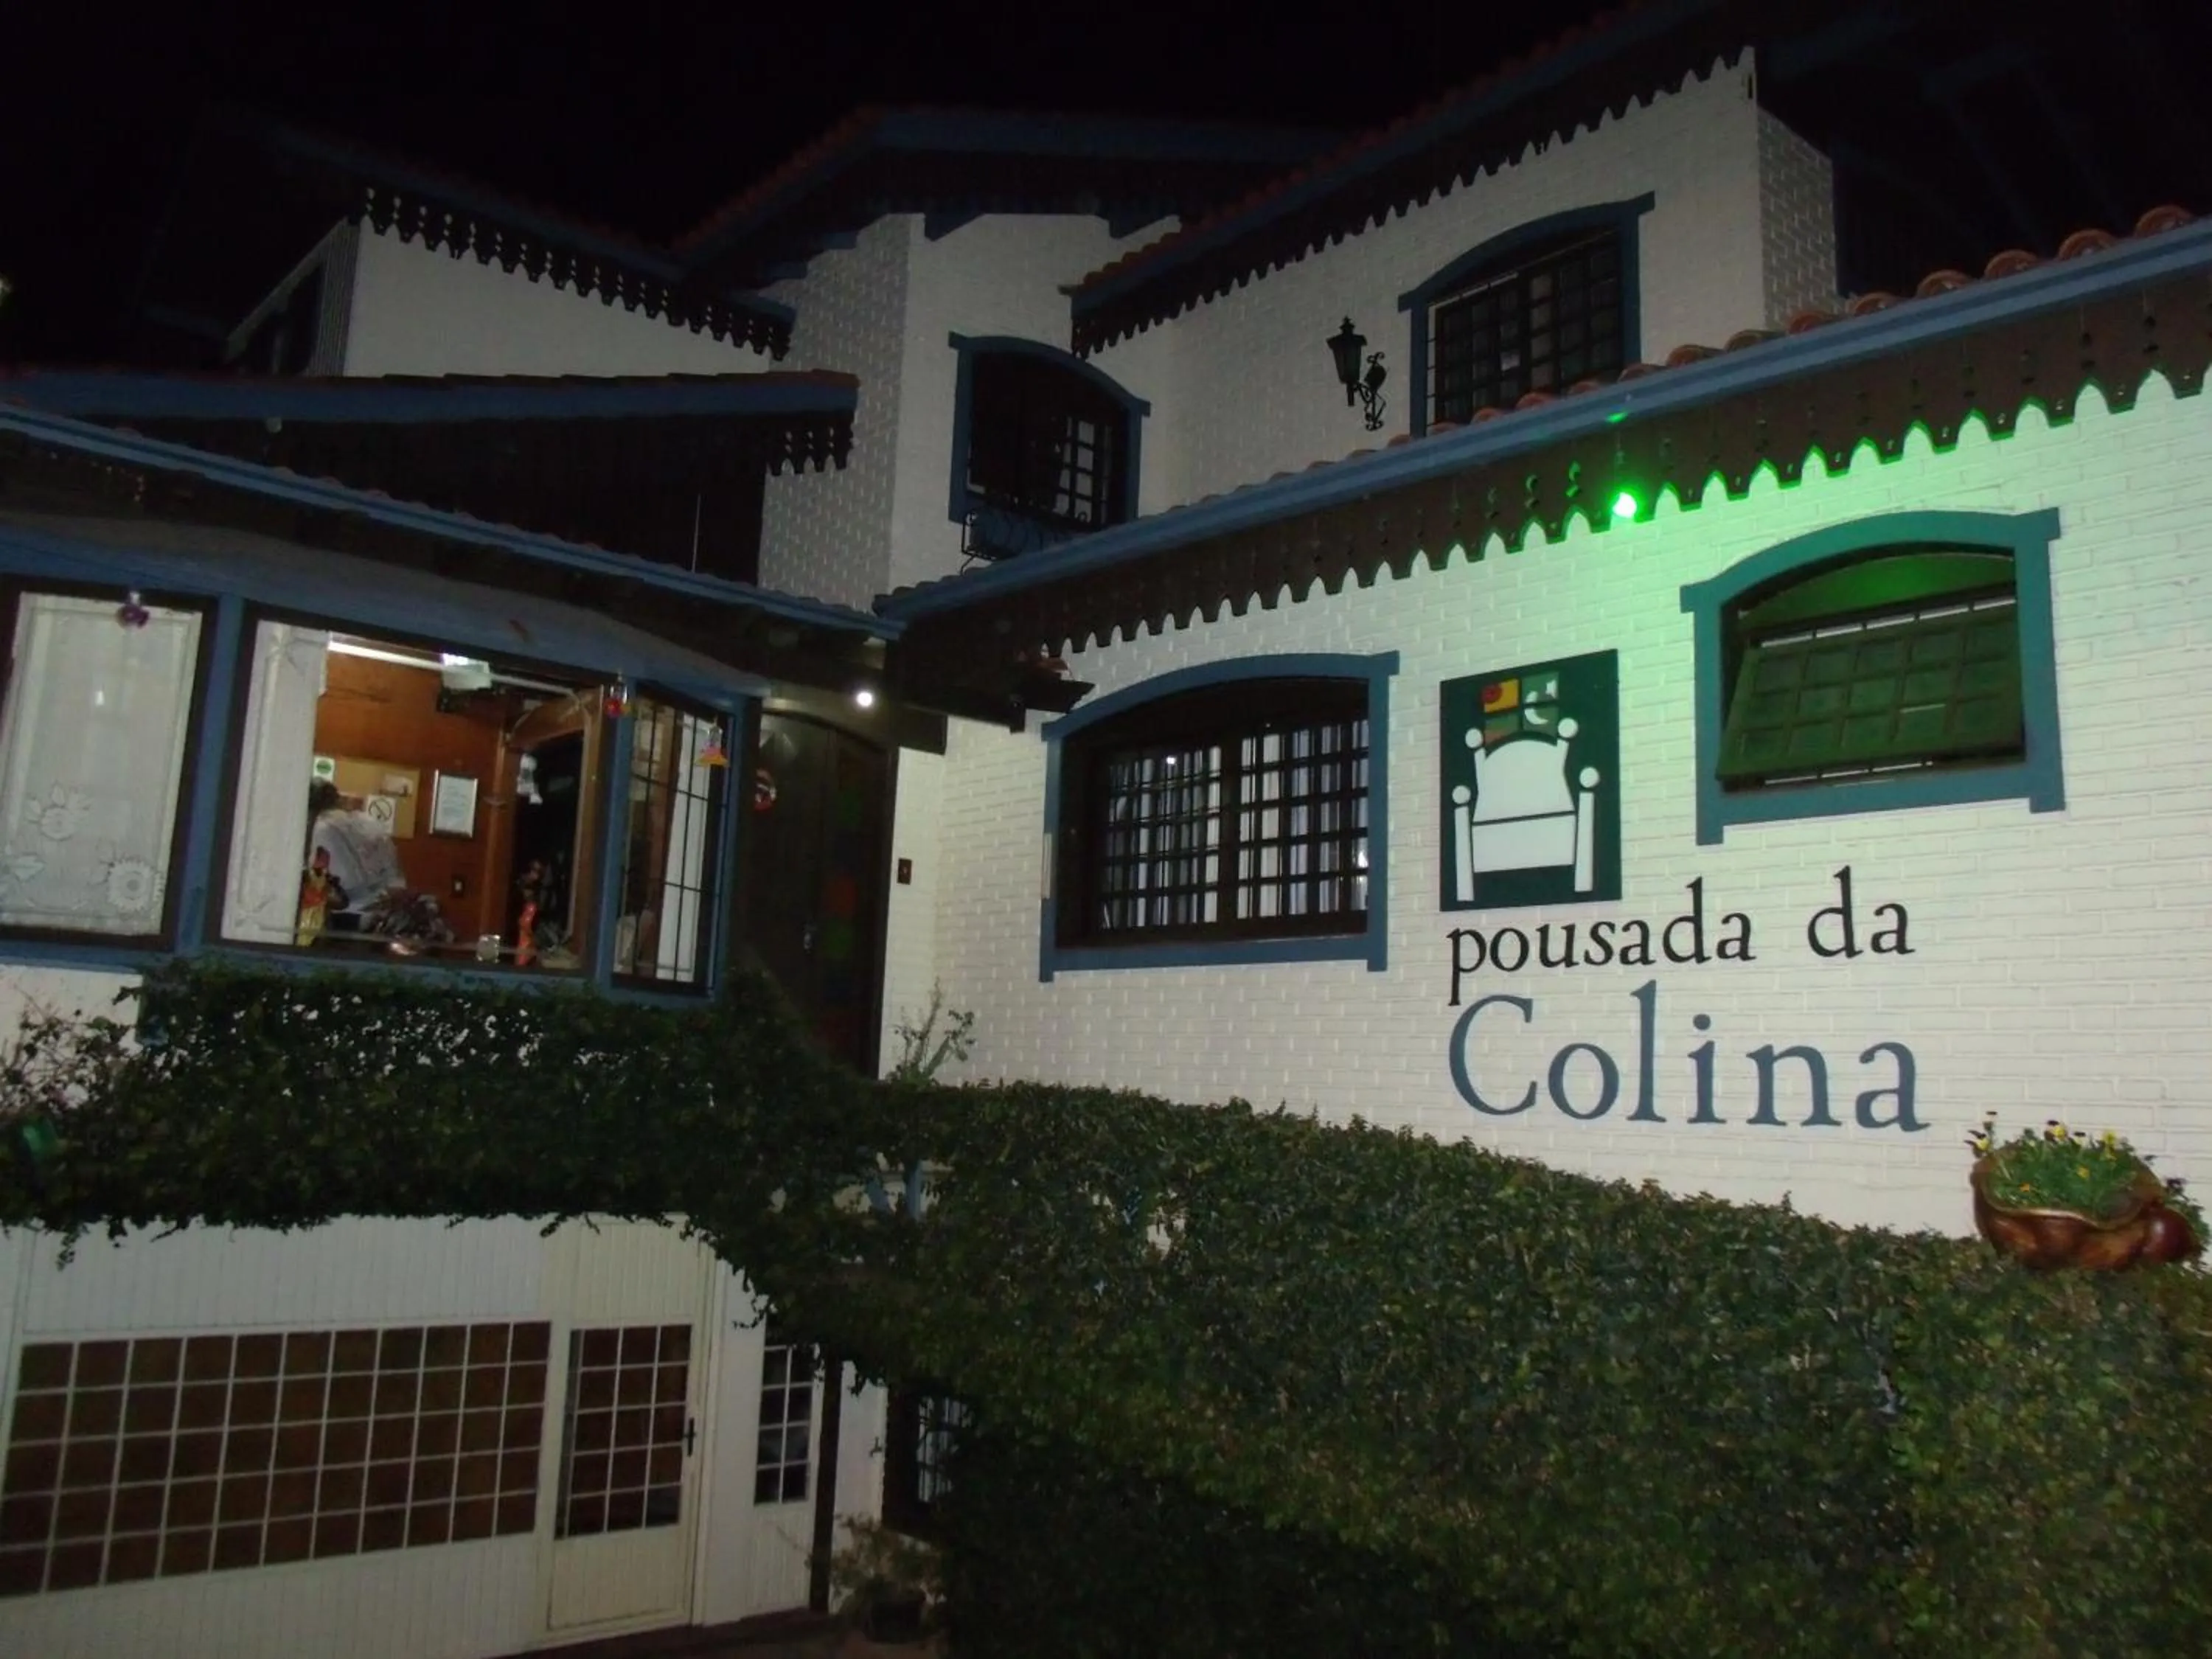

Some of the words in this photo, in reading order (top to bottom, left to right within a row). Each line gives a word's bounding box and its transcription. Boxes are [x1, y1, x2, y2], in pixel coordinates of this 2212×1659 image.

[1446, 876, 1756, 1006] pousada
[1807, 866, 1915, 958] da
[1449, 980, 1930, 1133] Colina
